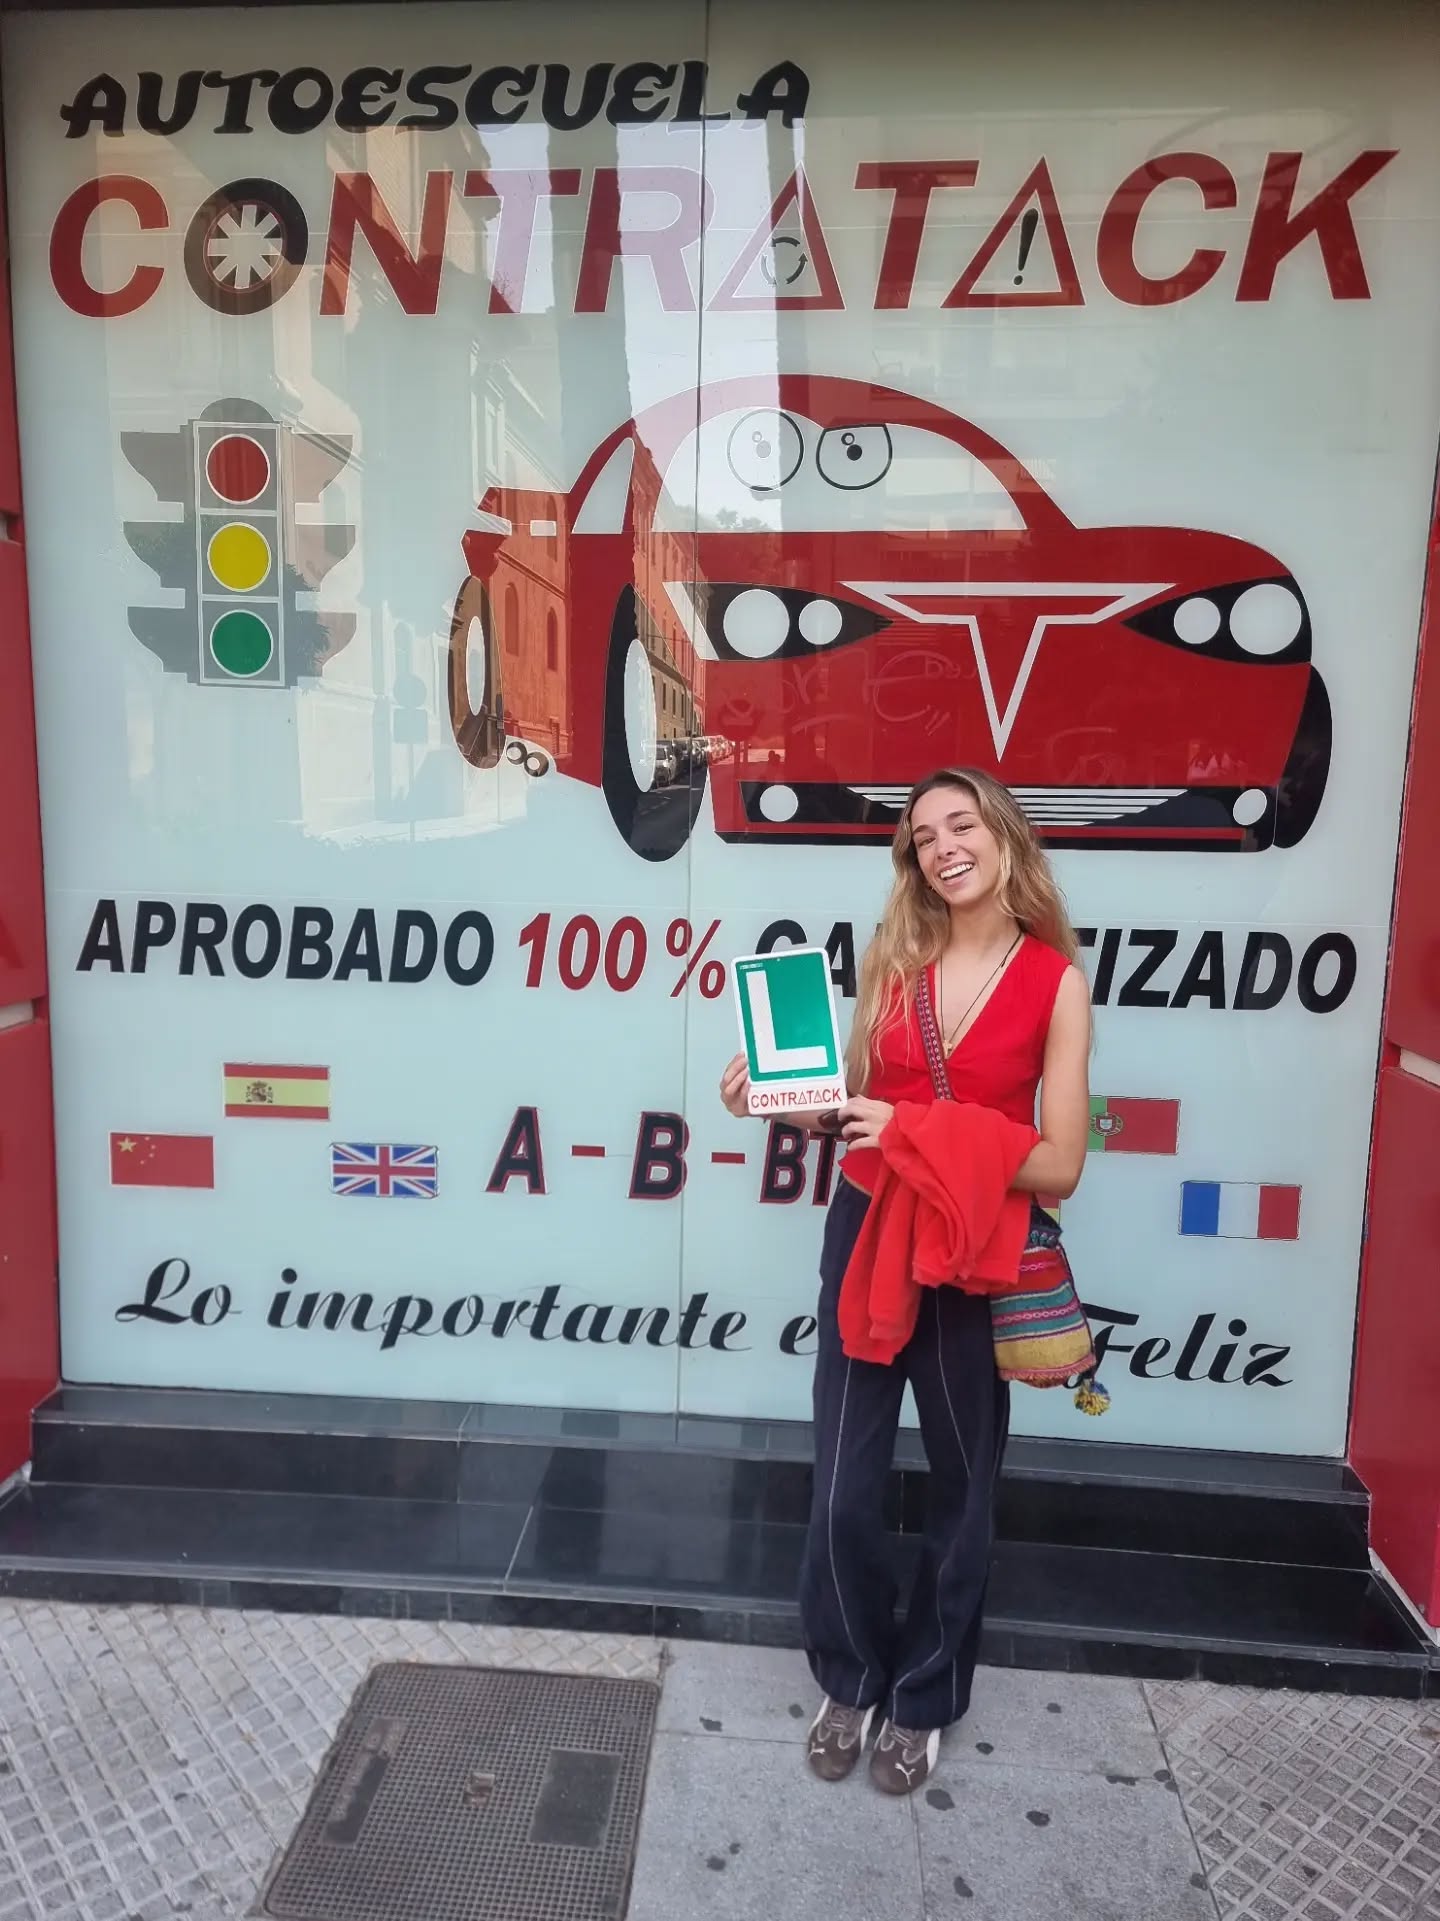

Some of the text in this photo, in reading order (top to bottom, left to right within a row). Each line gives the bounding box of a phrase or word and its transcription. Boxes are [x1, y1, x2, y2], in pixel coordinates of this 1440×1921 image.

[60, 61, 810, 139] AUTOESCUELA
[48, 149, 1400, 318] CONTRATACK
[76, 899, 494, 986] APROBADO
[518, 912, 648, 991] 100
[665, 917, 727, 999] %
[746, 970, 829, 1074] L
[751, 1087, 842, 1109] CONTRATACK
[114, 1257, 1294, 1389] Lo importante e Feliz
